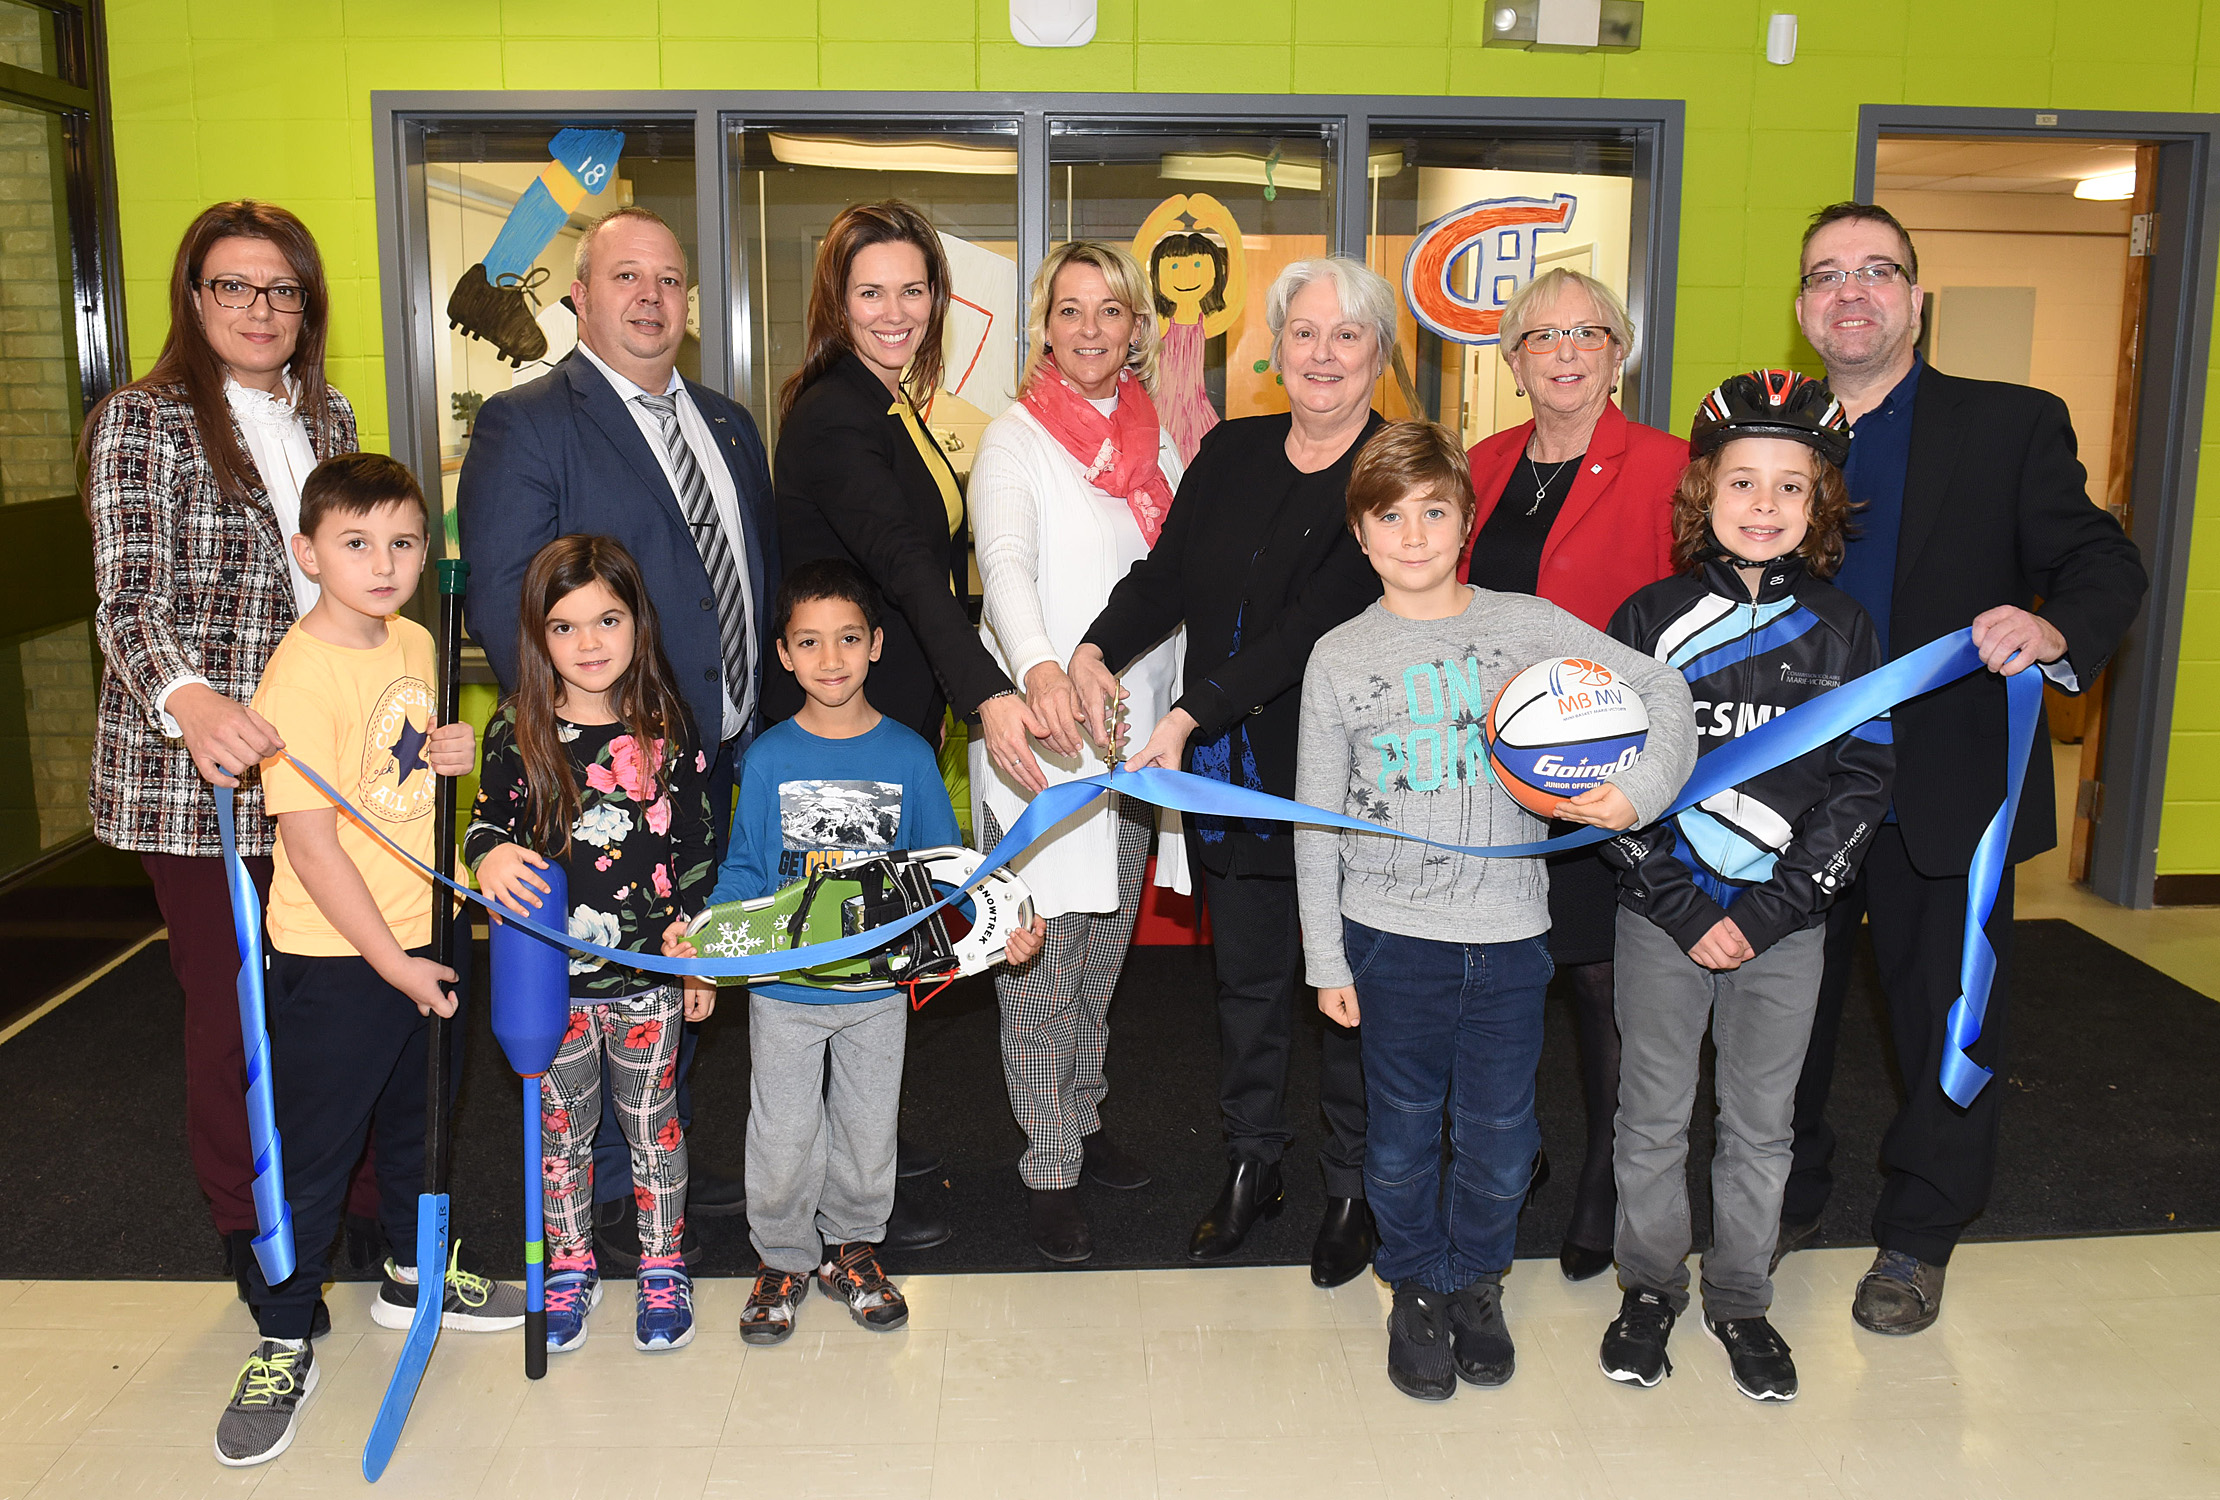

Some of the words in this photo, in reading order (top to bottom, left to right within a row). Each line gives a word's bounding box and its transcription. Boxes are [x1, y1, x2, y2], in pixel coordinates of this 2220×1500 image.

[577, 156, 606, 185] 18
[1403, 656, 1482, 725] ON
[1785, 676, 1841, 687] MARIE-VICTORIN
[1558, 692, 1592, 715] MB
[1595, 689, 1623, 705] MV
[1372, 723, 1495, 793] POIN
[371, 785, 407, 812] ALL
[413, 766, 436, 807] STA
[1544, 781, 1570, 789] JUNIOR
[976, 884, 997, 945] SNOWTREK
